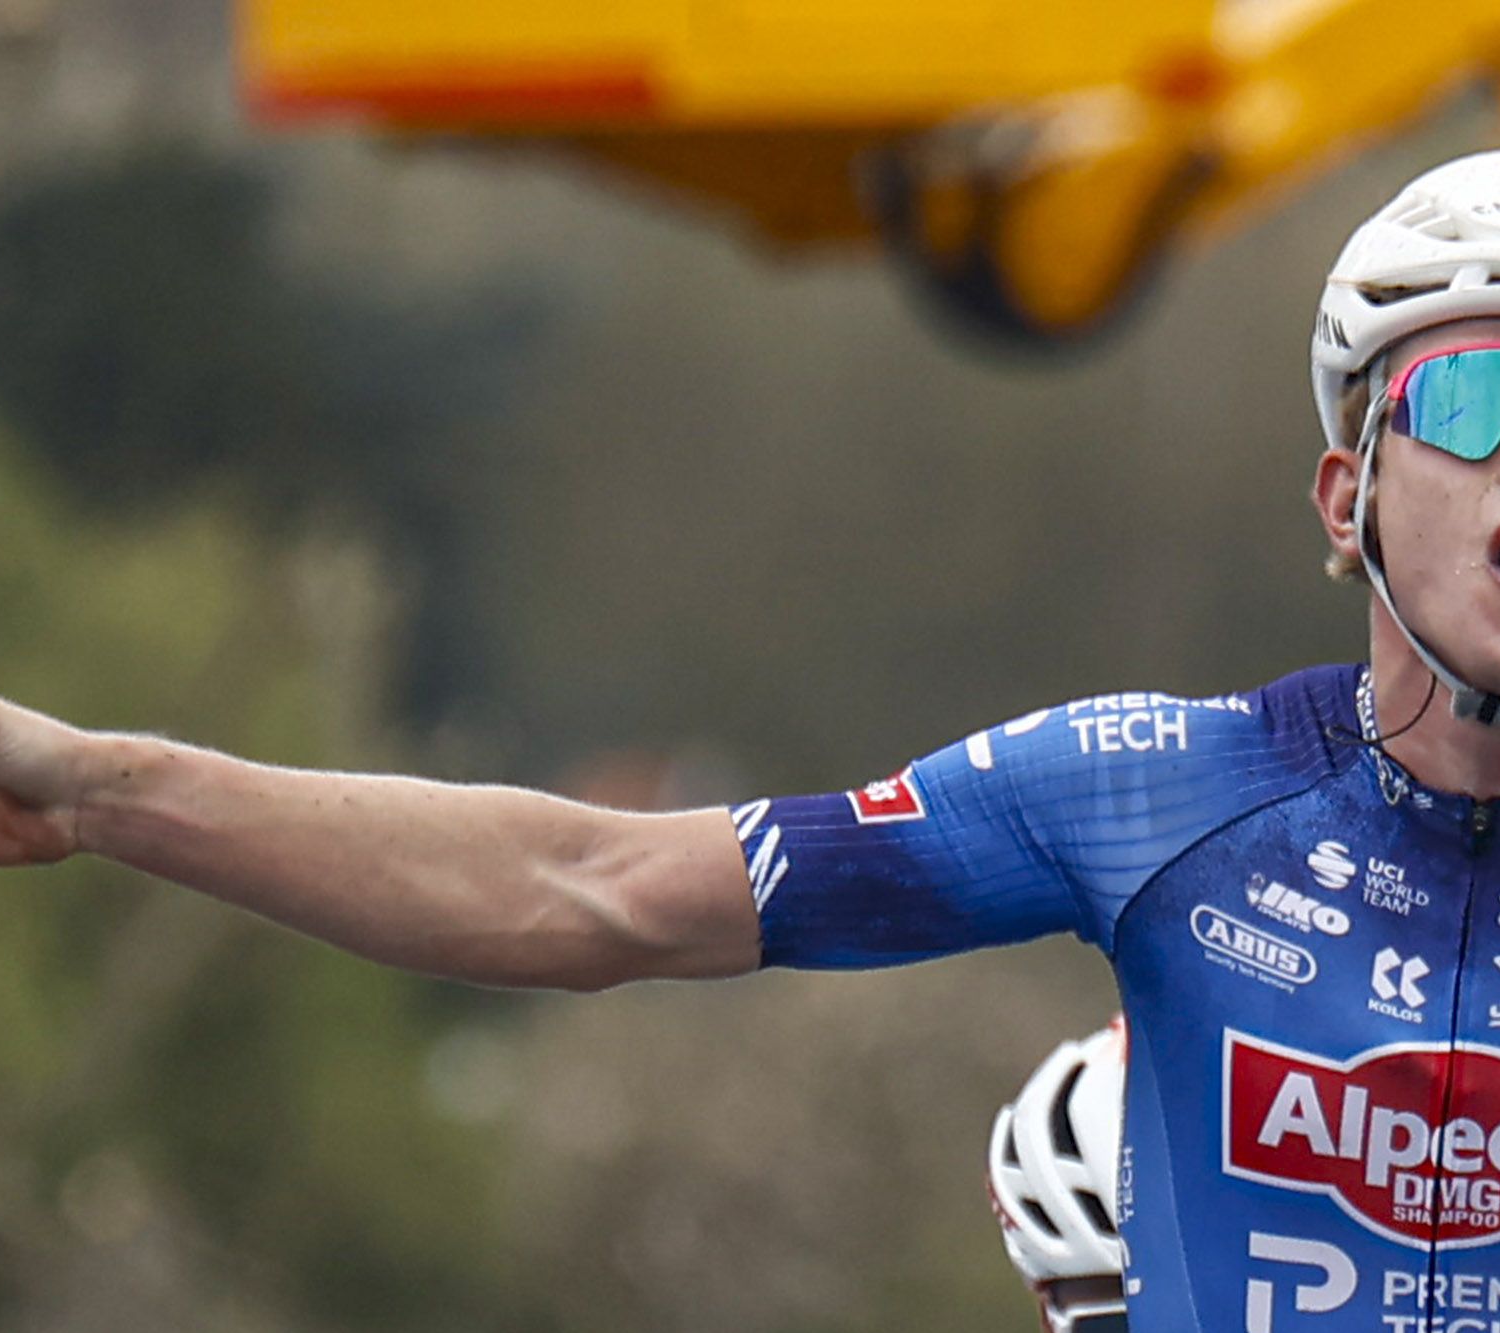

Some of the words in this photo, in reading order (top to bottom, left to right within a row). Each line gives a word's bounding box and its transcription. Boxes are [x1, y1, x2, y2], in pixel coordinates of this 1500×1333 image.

[1068, 709, 1188, 754] TECH
[1368, 857, 1405, 881] UCI
[1363, 887, 1411, 917] TEAM
[1365, 873, 1430, 906] WORLD
[1205, 917, 1300, 974] ABUS
[1392, 1206, 1500, 1228] SHAMPOO
